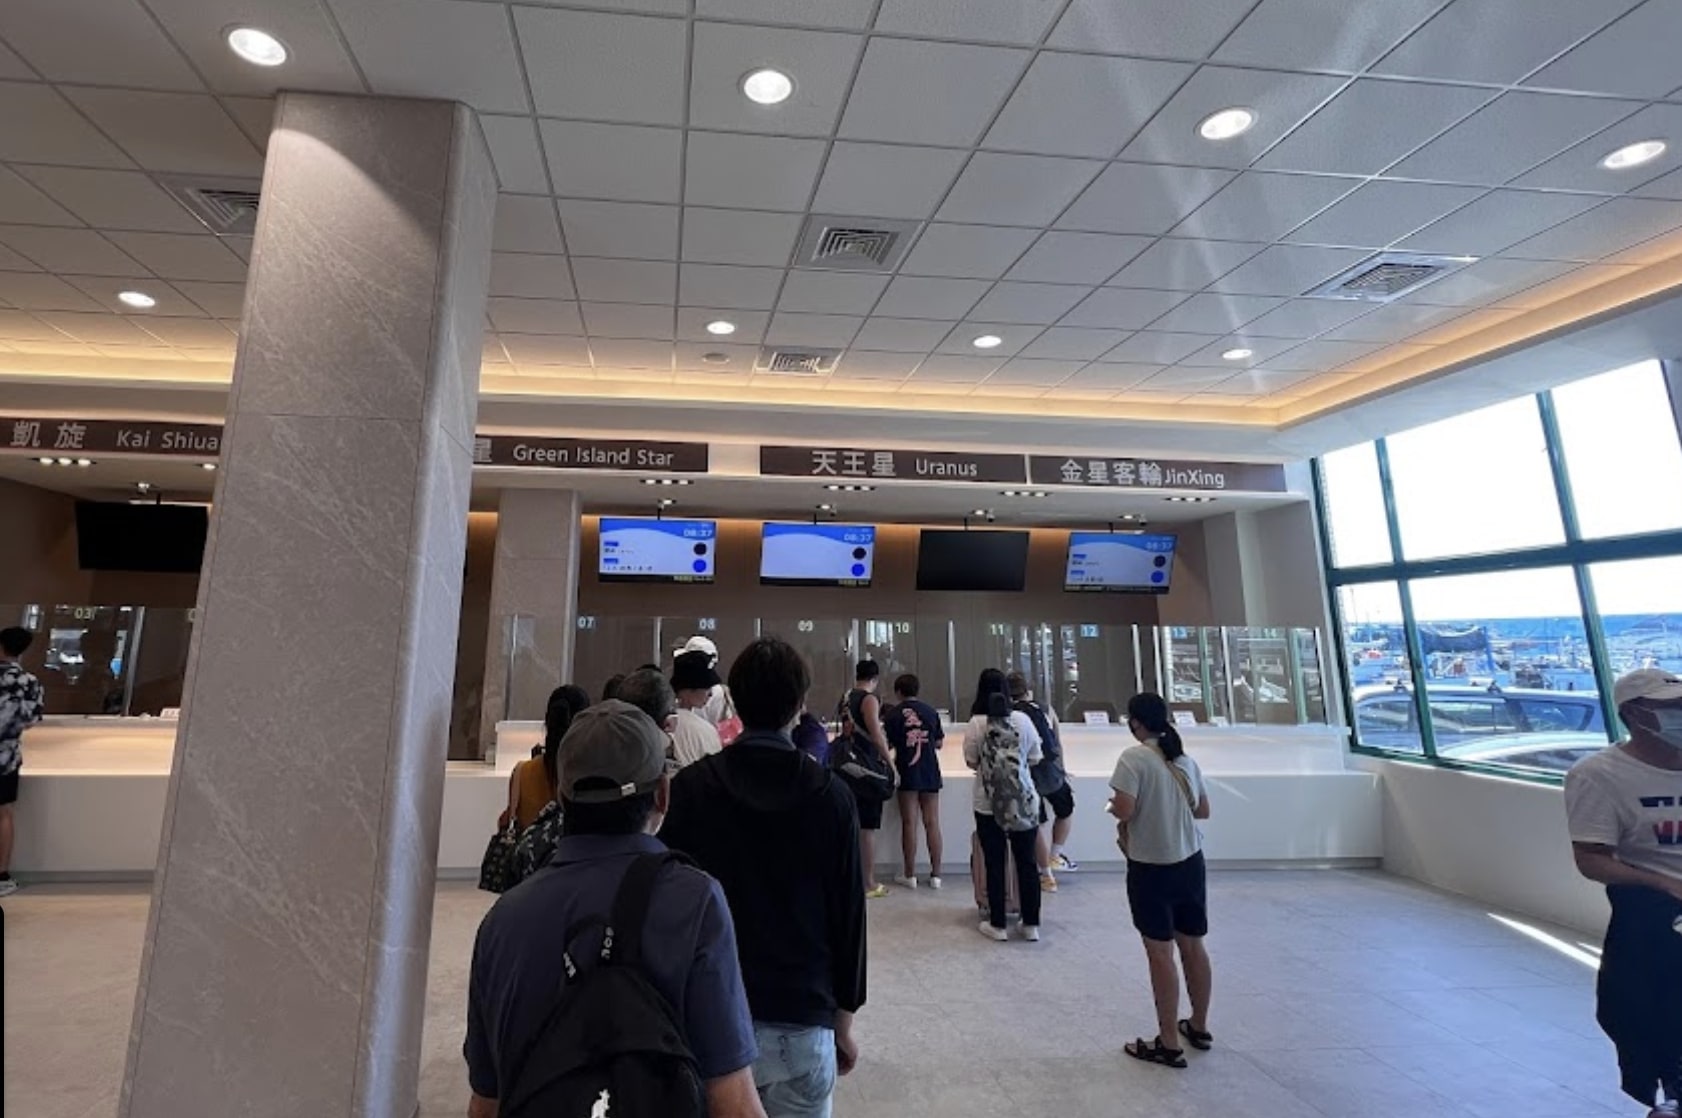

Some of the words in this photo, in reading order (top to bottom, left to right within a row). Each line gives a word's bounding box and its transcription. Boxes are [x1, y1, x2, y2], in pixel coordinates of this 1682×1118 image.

[10, 421, 86, 448] 凱旋
[116, 429, 151, 448] Kai
[513, 443, 569, 463] Green
[576, 446, 630, 465] Island
[637, 449, 675, 466] Star
[812, 450, 896, 477] 天王星
[915, 458, 978, 477] Uranus
[1060, 459, 1162, 486] 金星客輪
[1164, 468, 1225, 488] JinXing
[577, 617, 594, 629] 07
[699, 618, 716, 630] 08
[798, 620, 814, 632] 09
[895, 622, 910, 633] 10
[990, 624, 1005, 635] 11
[1082, 625, 1097, 637] 12
